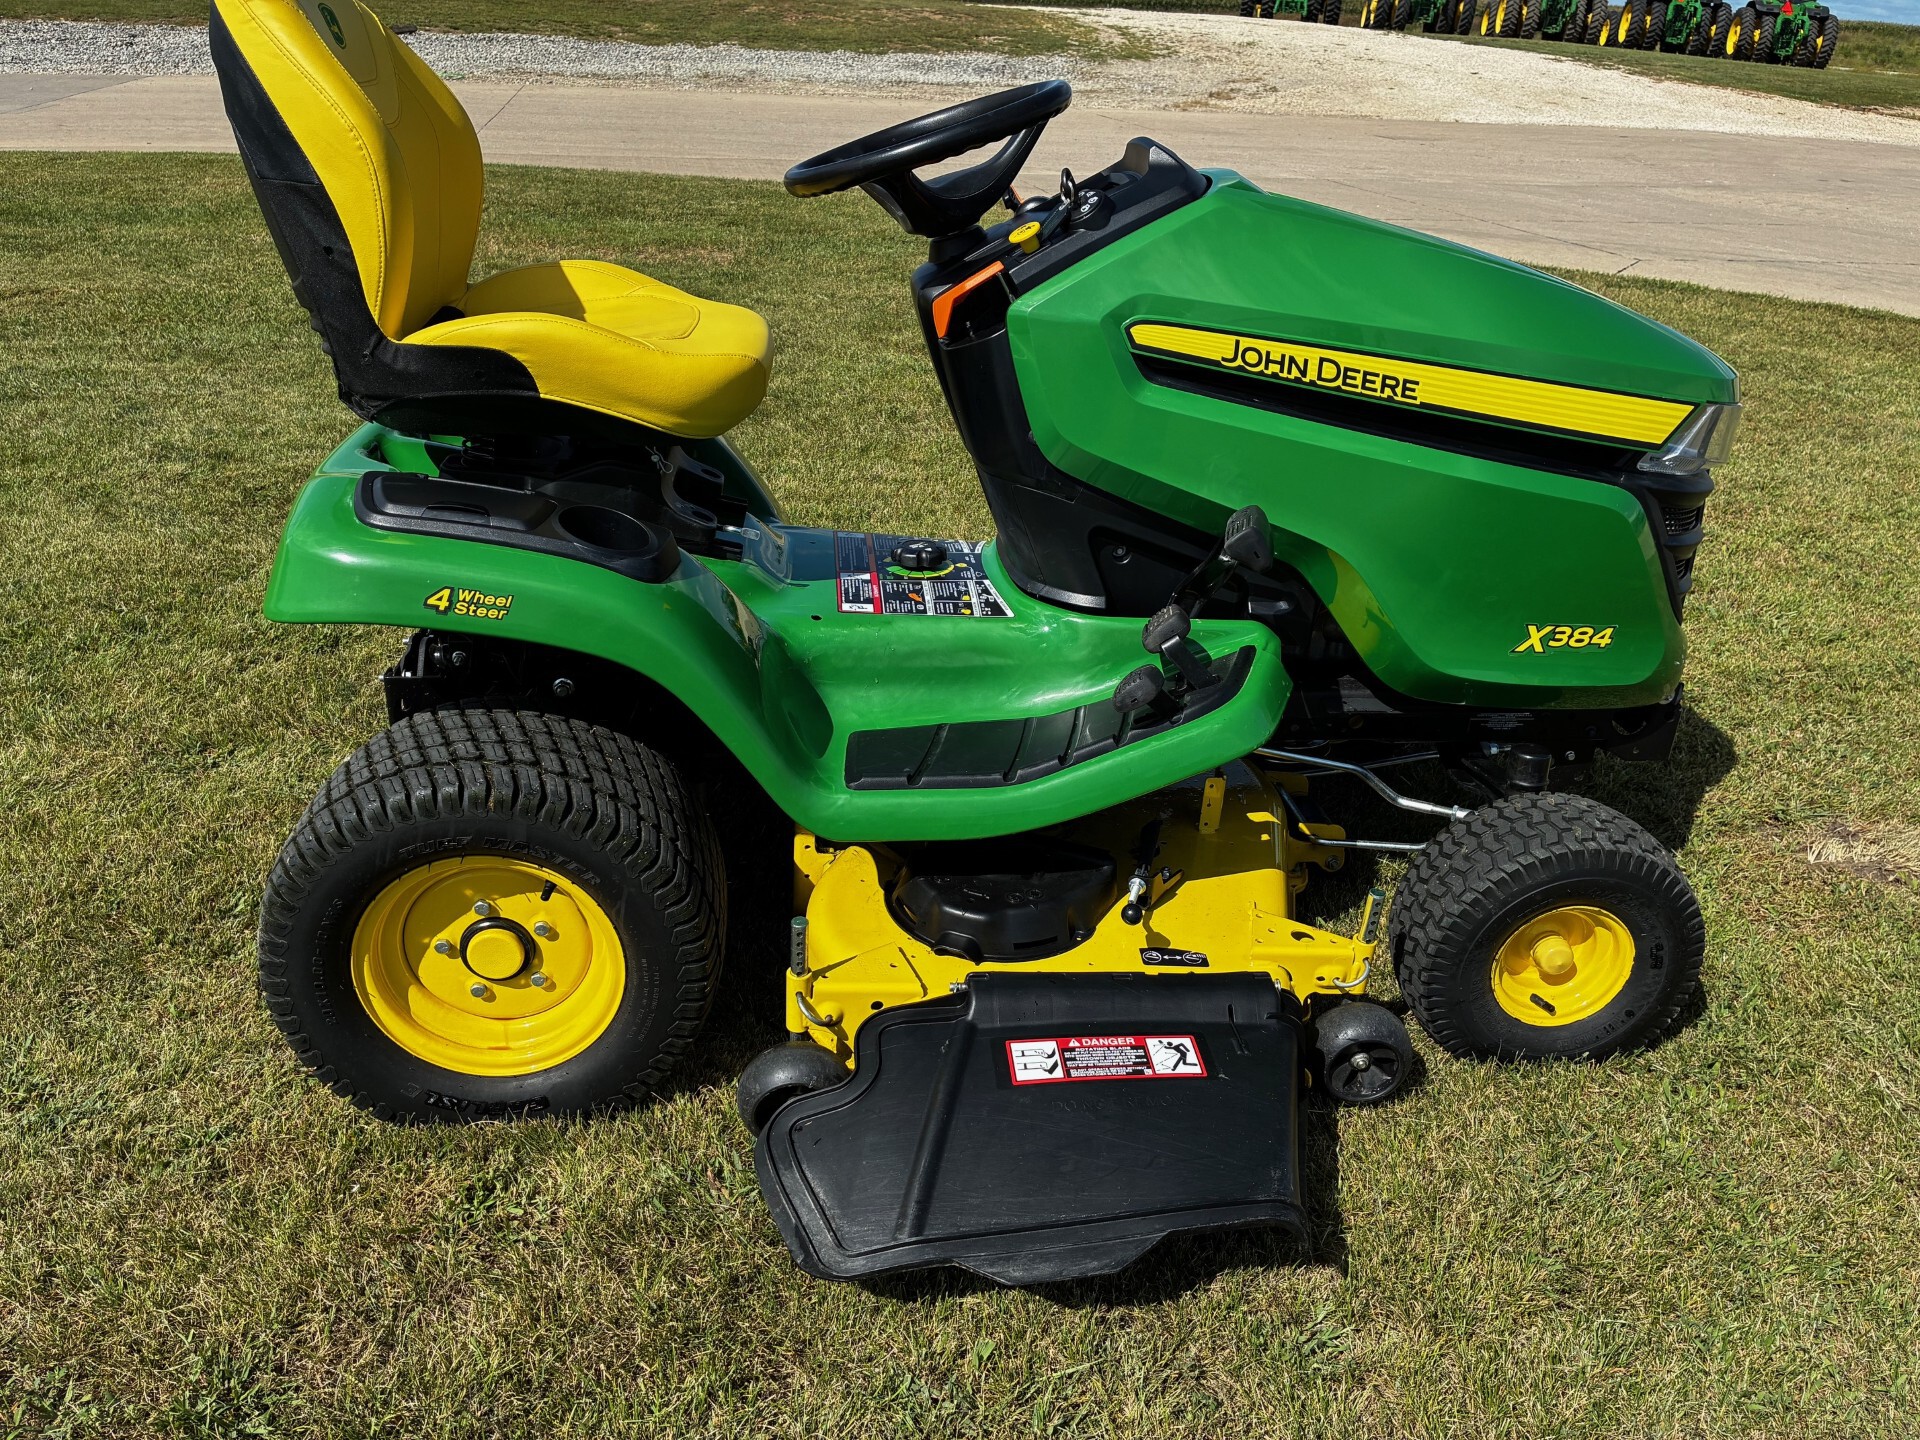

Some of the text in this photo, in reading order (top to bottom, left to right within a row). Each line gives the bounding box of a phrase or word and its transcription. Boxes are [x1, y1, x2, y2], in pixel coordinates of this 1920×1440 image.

[1221, 339, 1421, 402] JOHN DEERE
[425, 587, 513, 612] 4 Wheel
[453, 602, 508, 620] Steer
[1513, 624, 1616, 655] X384
[398, 835, 602, 886] TURF MASTER
[1082, 1037, 1136, 1046] DANGER
